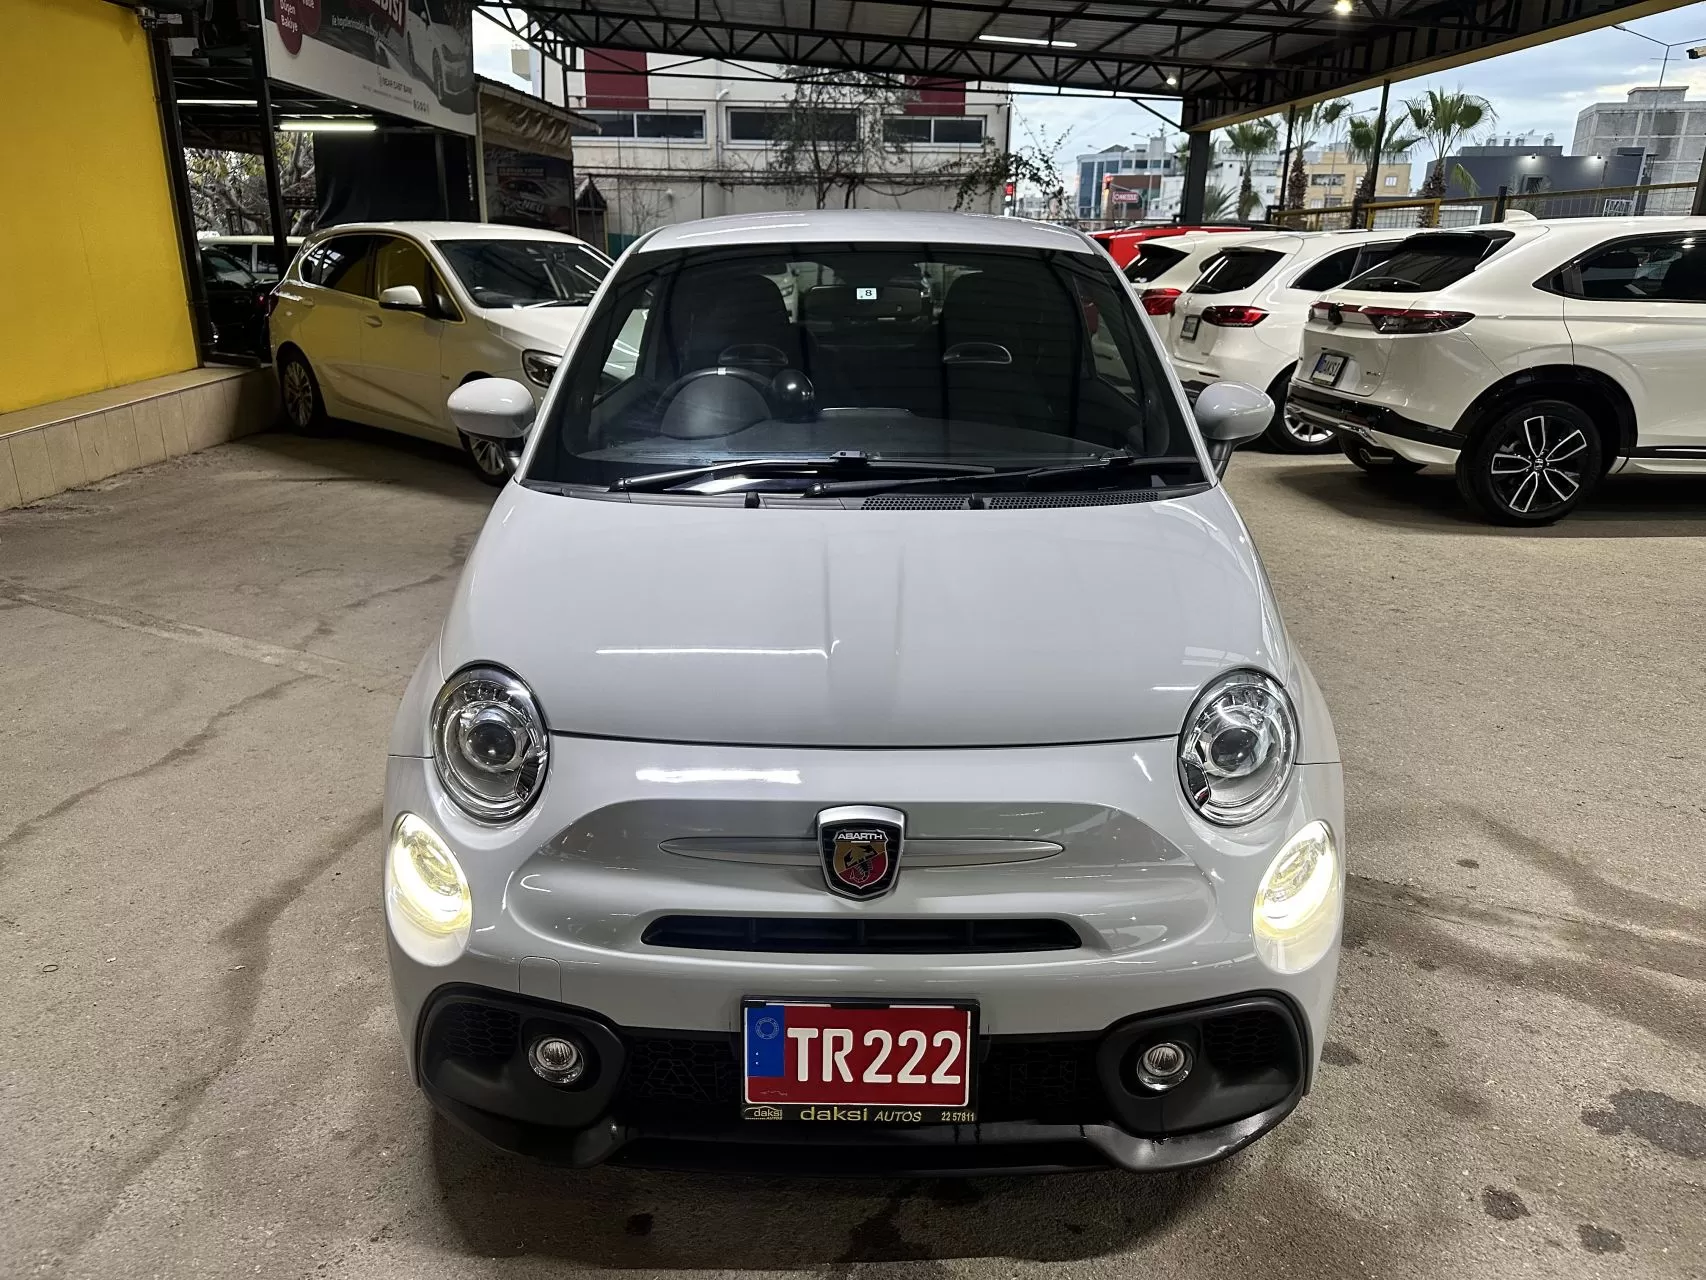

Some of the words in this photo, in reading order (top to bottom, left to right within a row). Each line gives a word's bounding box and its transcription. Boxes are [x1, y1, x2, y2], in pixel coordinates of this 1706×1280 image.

[280, 12, 298, 33] Bakiye
[837, 832, 883, 840] ABARTH
[800, 1106, 868, 1122] daksi
[874, 1110, 922, 1122] AUTOS
